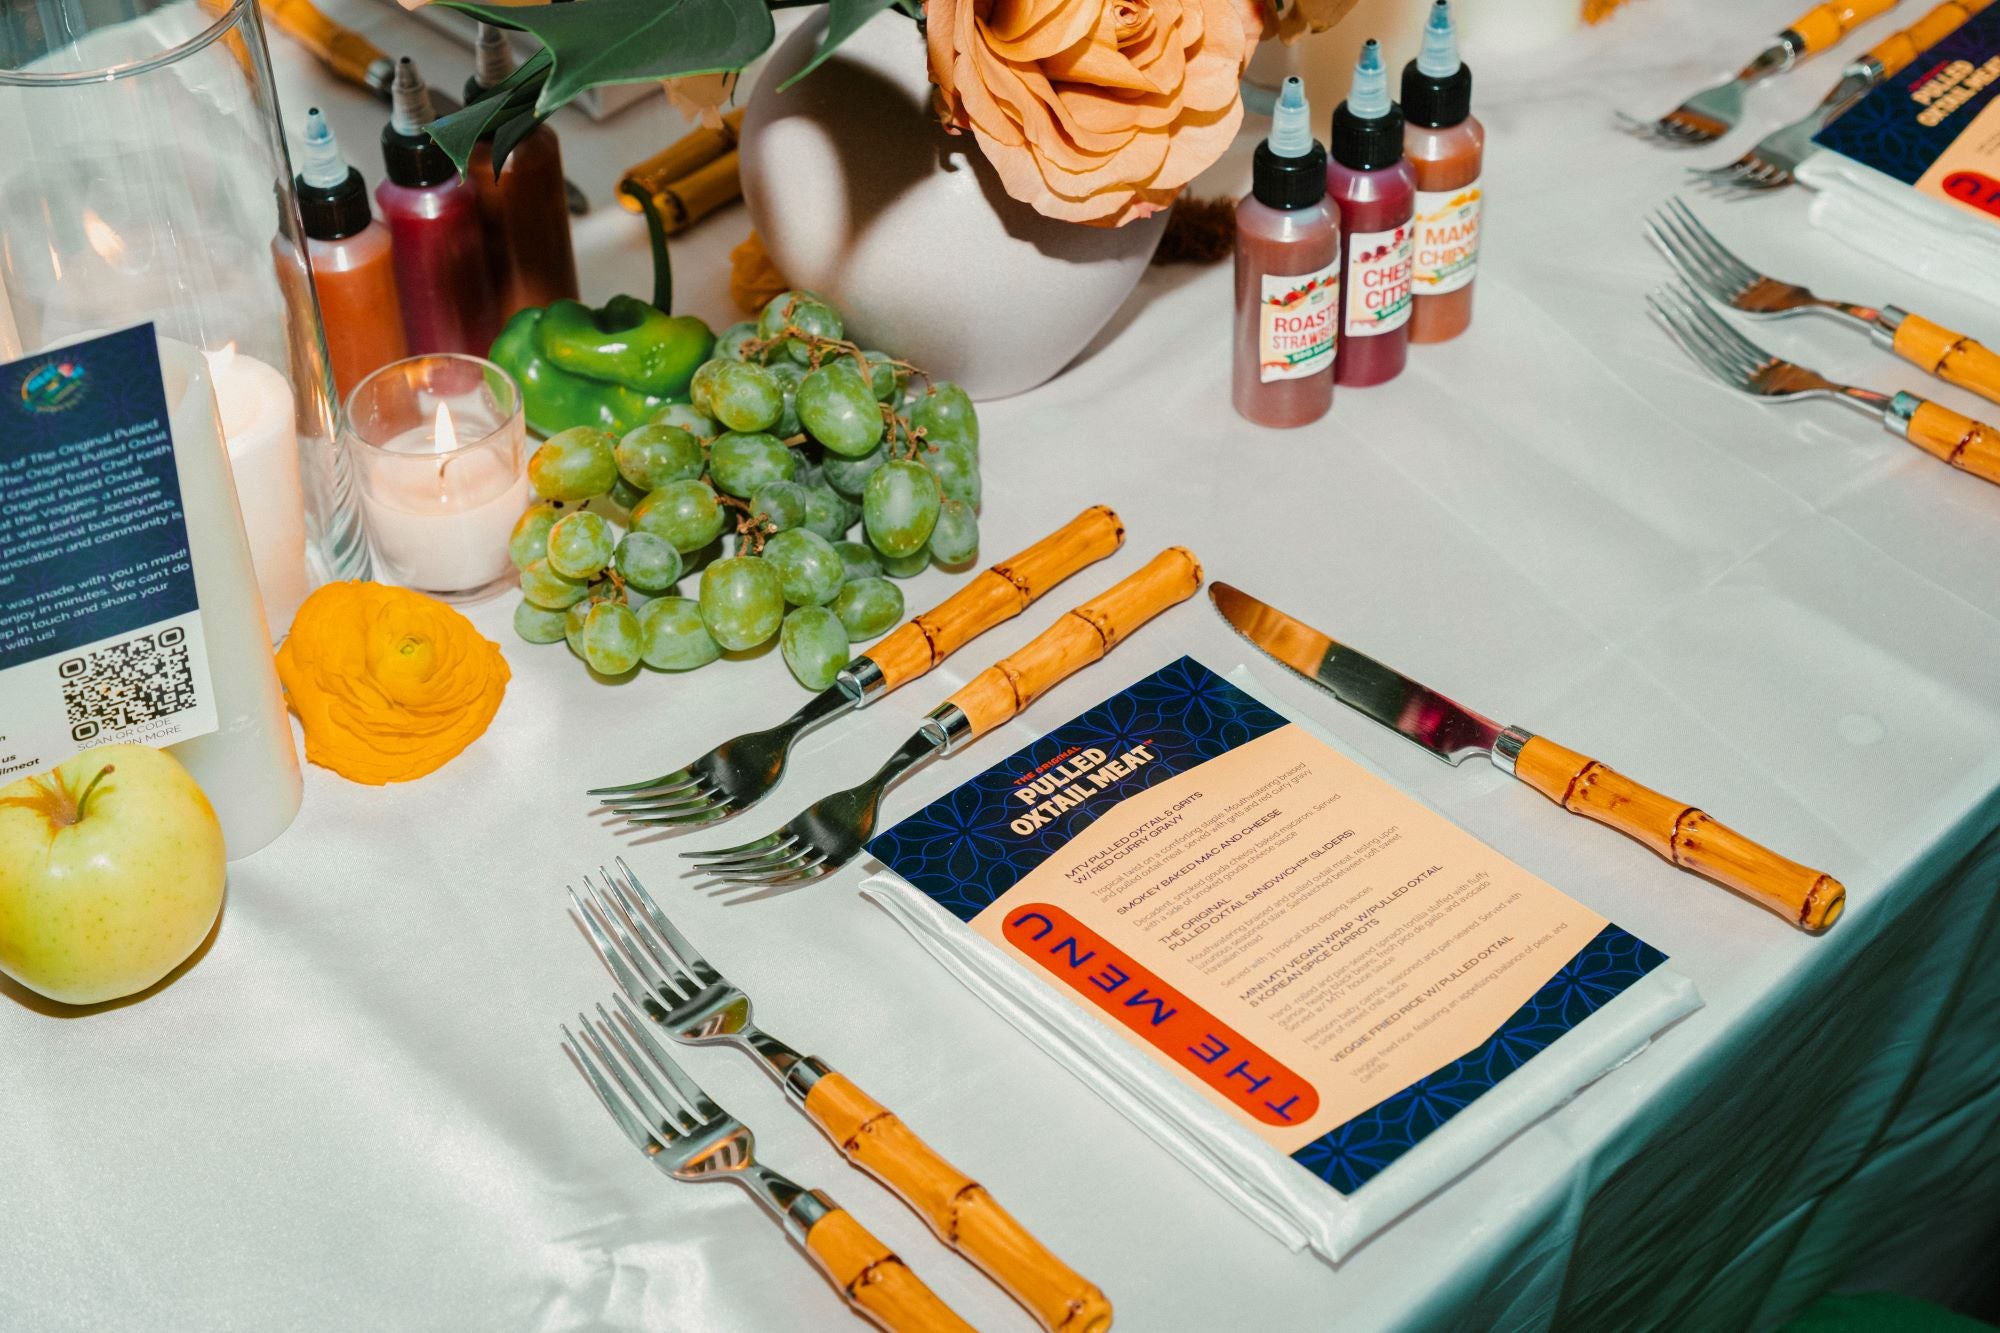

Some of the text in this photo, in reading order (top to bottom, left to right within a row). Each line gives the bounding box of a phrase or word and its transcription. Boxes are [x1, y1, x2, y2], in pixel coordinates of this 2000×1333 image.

[11, 456, 26, 469] of
[30, 450, 56, 463] The
[58, 432, 112, 455] Original
[114, 418, 159, 439] Pulled
[25, 457, 80, 480] Original
[81, 442, 127, 464] Pulled
[127, 430, 167, 449] Oxtail
[2, 493, 56, 517] Original
[57, 478, 103, 499] Pulled
[104, 465, 144, 485] Oxtail
[6, 477, 64, 499] creation
[65, 466, 100, 482] from
[100, 453, 134, 472] Chef
[135, 445, 171, 462] Keith
[14, 513, 38, 526] the
[101, 491, 111, 500] a
[112, 475, 160, 496] mobile
[16, 489, 162, 538] with partner Jocelyne
[0, 511, 182, 572] nnovation and community is
[3, 499, 176, 558] professional backgrounds
[6, 548, 187, 610] was made with you in mind!
[38, 604, 52, 614] in
[111, 579, 136, 591] We
[137, 567, 170, 584] can't
[171, 562, 190, 574] do
[16, 582, 168, 634] in touch and share your
[5, 628, 56, 650] with us!
[2, 754, 17, 763] us
[77, 735, 113, 751] SCAN
[116, 729, 134, 740] QR
[137, 717, 172, 733] CODE
[145, 724, 183, 741] MORE
[1013, 746, 1082, 785] THE ORIGINAL
[1014, 748, 1107, 806] PULLED
[1010, 783, 1098, 836] OXTAIL
[1064, 861, 1089, 879] MTV
[1087, 836, 1130, 864] PULLED
[1128, 815, 1167, 838] OXTAIL
[1172, 791, 1203, 811] GRITS
[1090, 858, 1114, 874] RED
[1113, 835, 1149, 860] CURRY
[1149, 813, 1183, 837] GRAVY
[1116, 808, 1283, 915] SMOKEY BAKED MAC AND CHEESE
[1168, 922, 1211, 951] PULLED
[1209, 900, 1248, 924] OXTAIL
[1308, 829, 1355, 860] (SLIDERS)
[1158, 898, 1232, 943] THE ORIGINAL
[1239, 982, 1265, 1001] MINI
[1262, 966, 1287, 985] MTV
[1285, 942, 1324, 968] VEGAN
[1320, 921, 1354, 944] WRAP
[1406, 865, 1443, 888] OXTAIL
[1257, 969, 1304, 1002] KOREAN
[1300, 949, 1333, 972] SPICE
[1330, 918, 1380, 952] CARROTS
[1011, 912, 1300, 1121] THE MENU
[1329, 1033, 1371, 1062] VEGGIE
[1368, 1012, 1401, 1036] FRIED
[1398, 995, 1426, 1015] RICE
[1437, 958, 1479, 987] PULLED
[1477, 935, 1514, 960] OXTAIL
